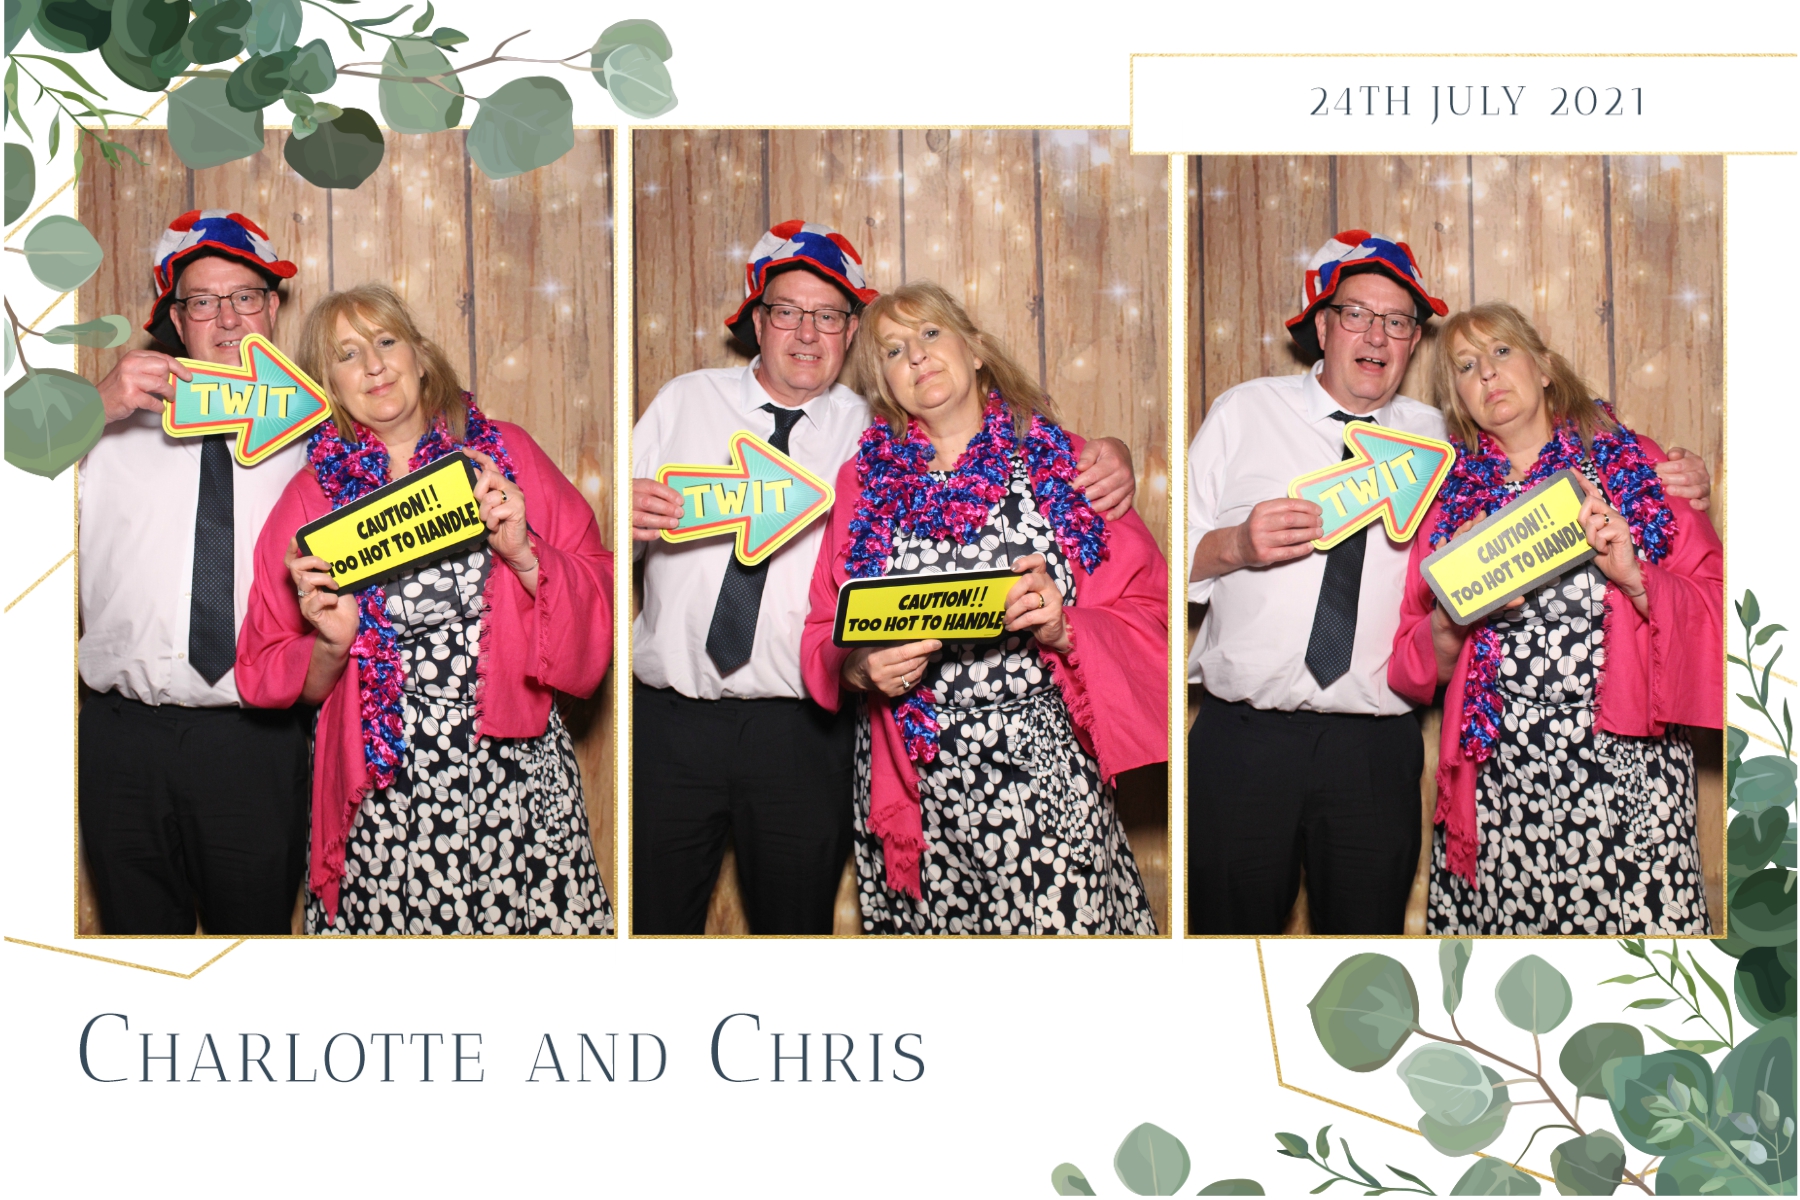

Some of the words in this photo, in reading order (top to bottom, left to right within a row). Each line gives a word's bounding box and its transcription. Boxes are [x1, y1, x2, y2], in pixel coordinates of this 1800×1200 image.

[190, 382, 298, 419] TWIT
[683, 478, 793, 518] TWIT
[1318, 448, 1418, 518] TWIT
[356, 484, 442, 540] CAUTION!!
[358, 538, 392, 567] HOT
[391, 531, 416, 553] TO
[414, 501, 480, 545] HANDLE
[1477, 503, 1555, 564] CAUTION!!
[1450, 580, 1484, 606] TOO
[1481, 562, 1515, 590] HOT
[1511, 551, 1536, 573] TO
[1532, 518, 1587, 564] HANDL
[848, 618, 882, 632] TOO
[883, 615, 920, 631] HOT
[921, 614, 943, 631] TO
[942, 610, 1006, 631] HANDLE
[898, 586, 989, 611] CAUTION!!
